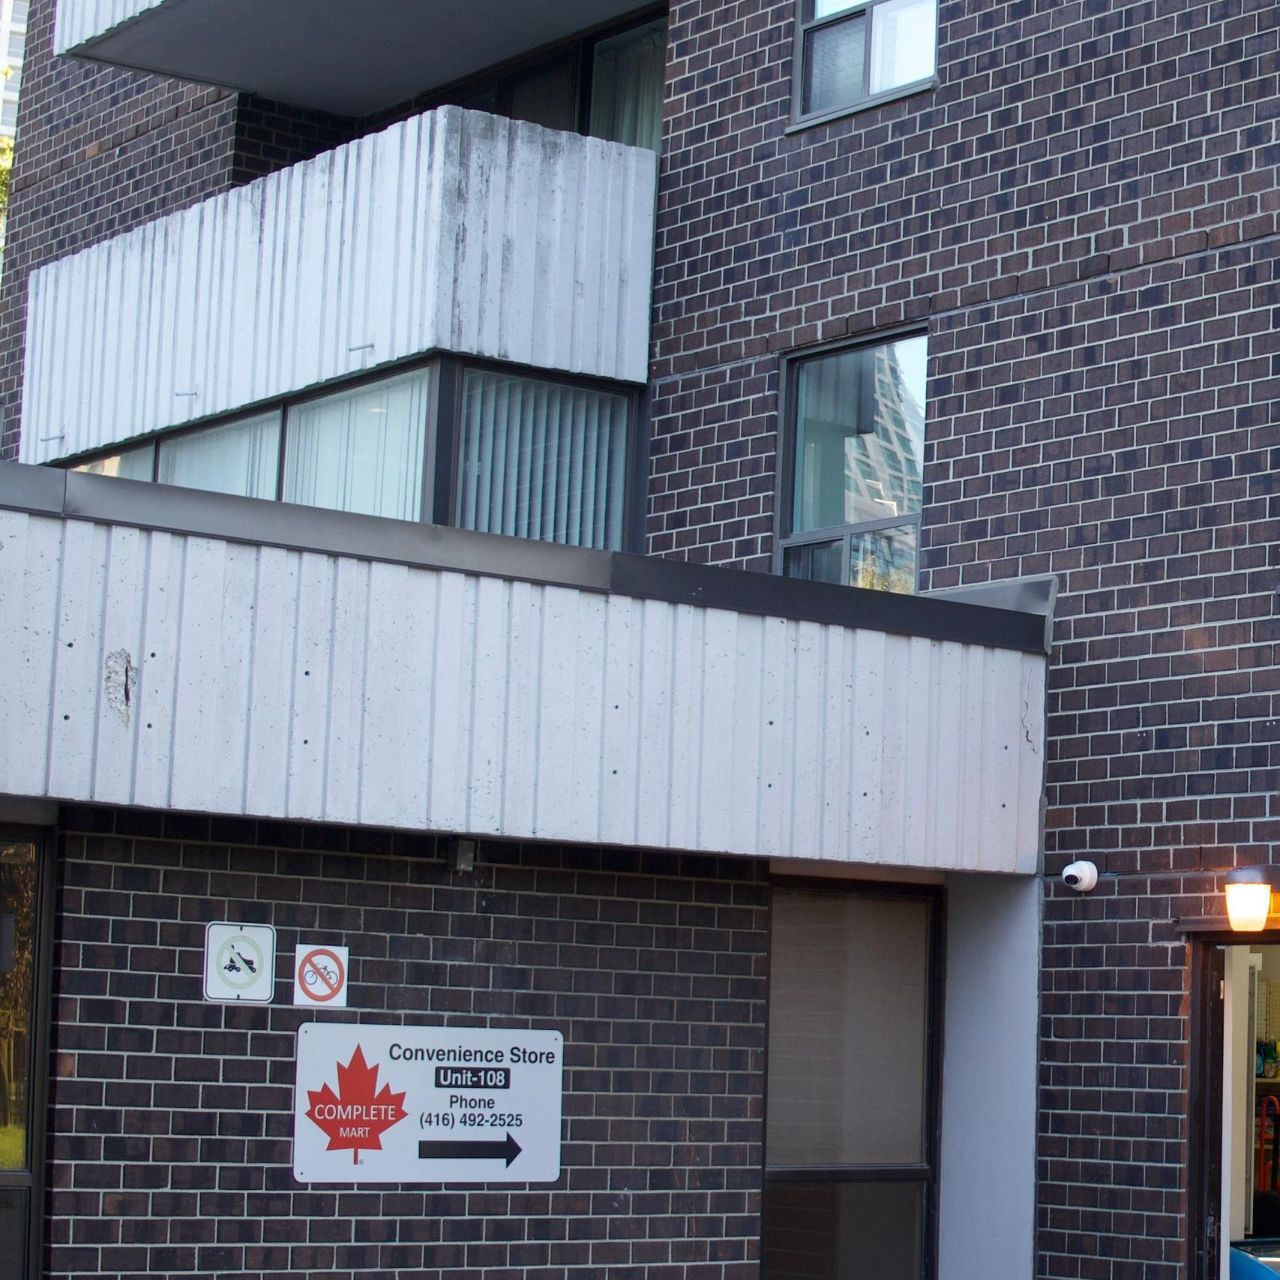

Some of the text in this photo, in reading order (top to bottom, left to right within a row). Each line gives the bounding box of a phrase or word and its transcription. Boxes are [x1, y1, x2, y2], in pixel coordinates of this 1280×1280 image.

[388, 1043, 556, 1064] Convenience Store
[439, 1069, 506, 1086] Unit-108
[449, 1094, 496, 1109] Phone
[314, 1104, 396, 1120] COMPLETE
[419, 1112, 523, 1129] (416) 492-2525
[339, 1126, 371, 1138] MART
